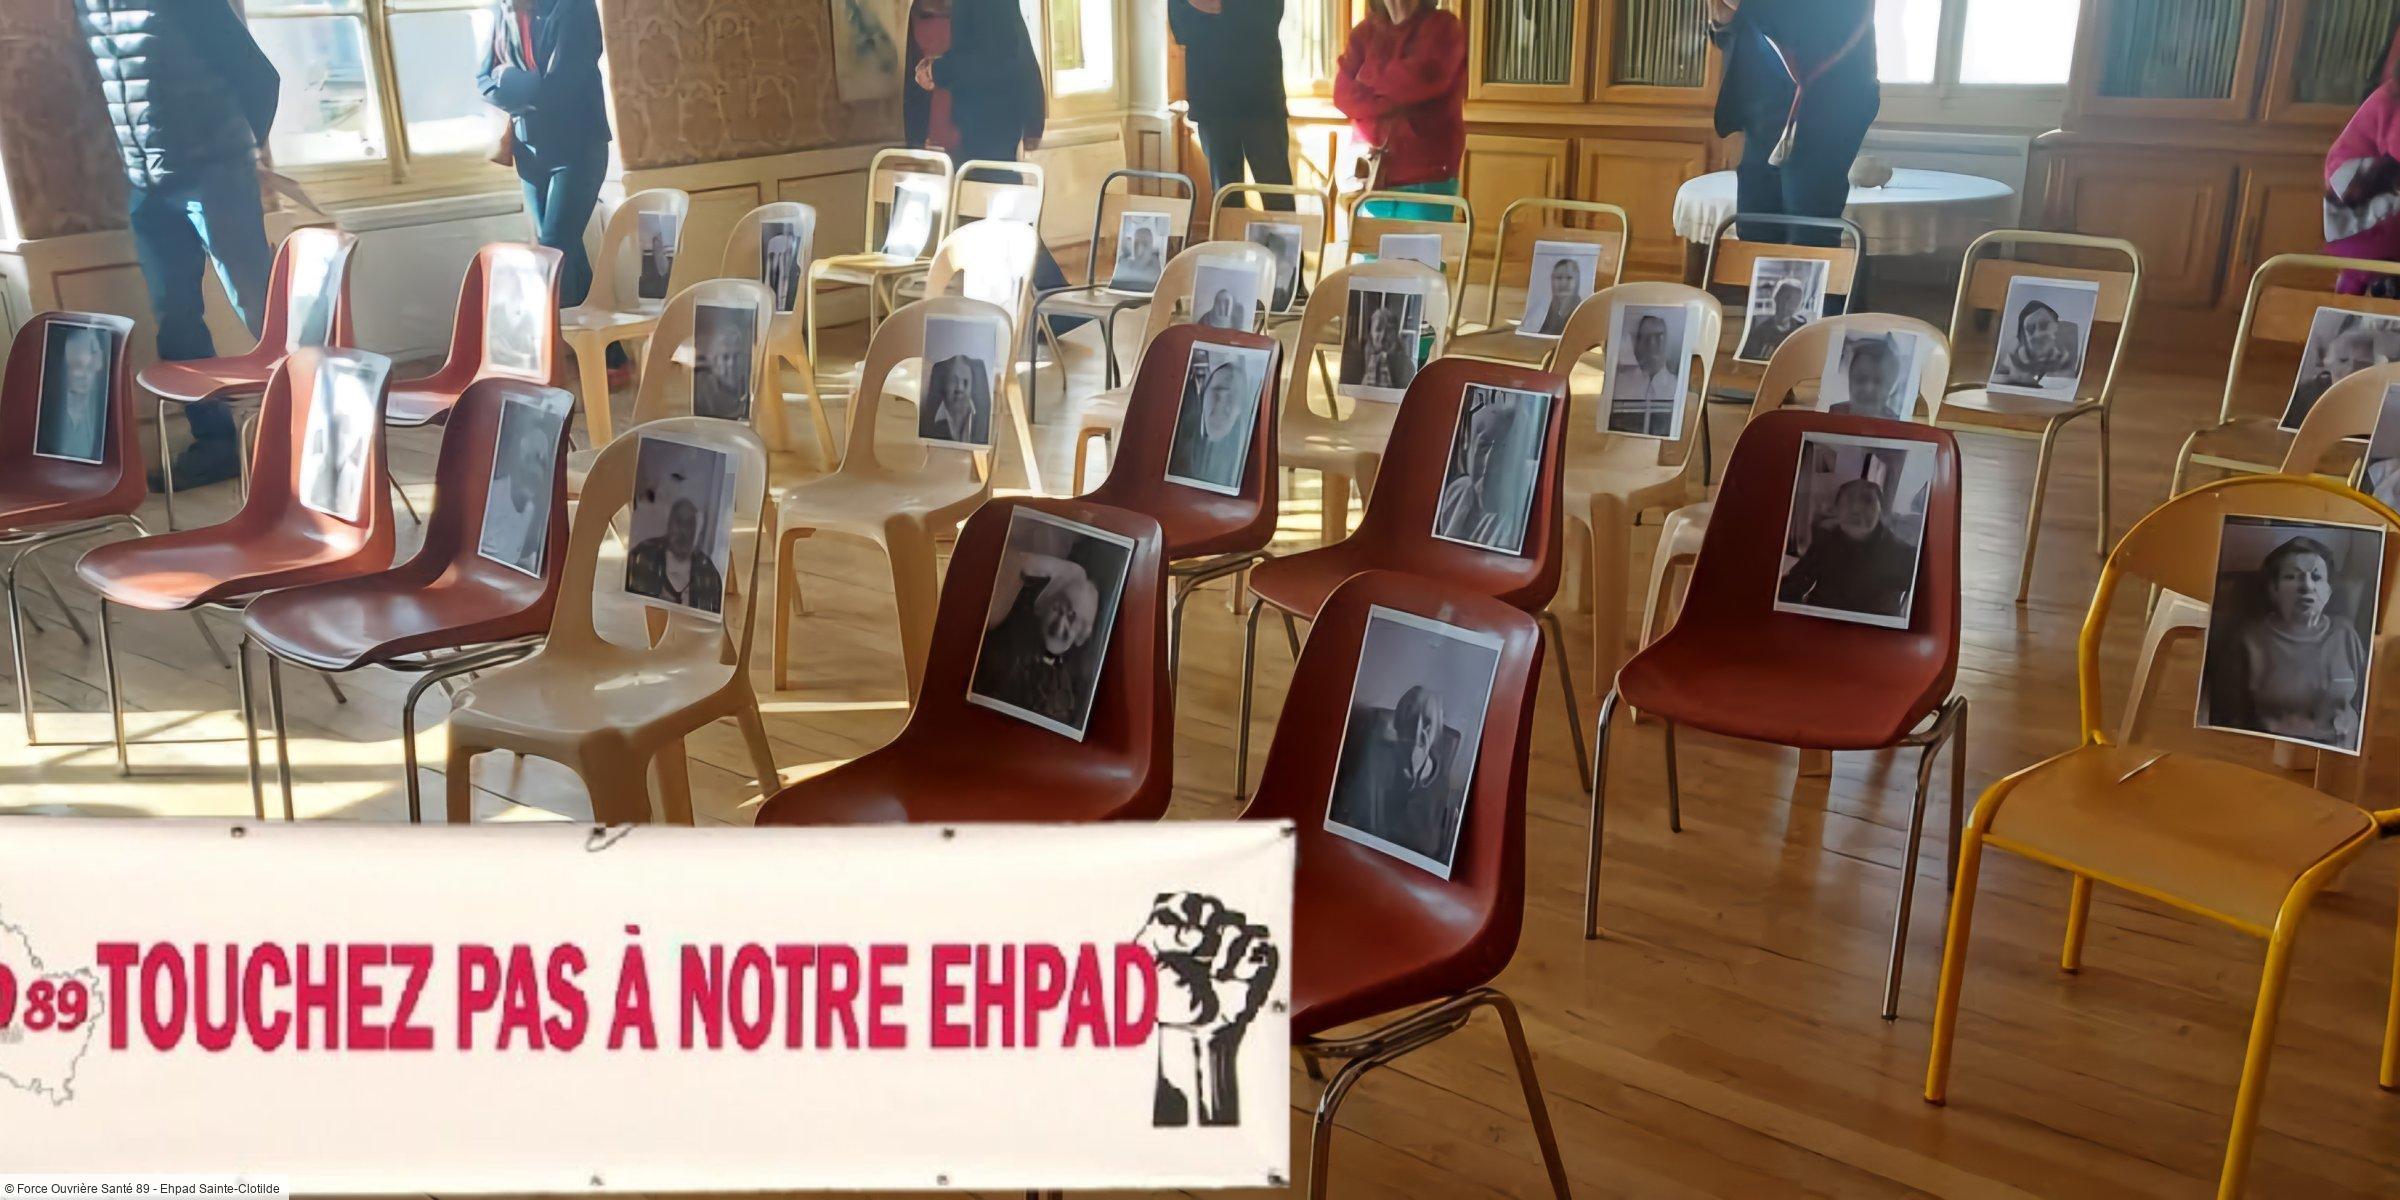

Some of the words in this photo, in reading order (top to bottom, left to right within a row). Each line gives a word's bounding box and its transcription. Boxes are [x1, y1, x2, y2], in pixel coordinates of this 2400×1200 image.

[23, 979, 88, 1032] 89
[96, 940, 434, 1052] TOUCHEZ
[457, 942, 589, 1052] PAS
[607, 924, 657, 1050] À
[679, 942, 908, 1052] NOTRE
[930, 942, 1159, 1050] EHPAD
